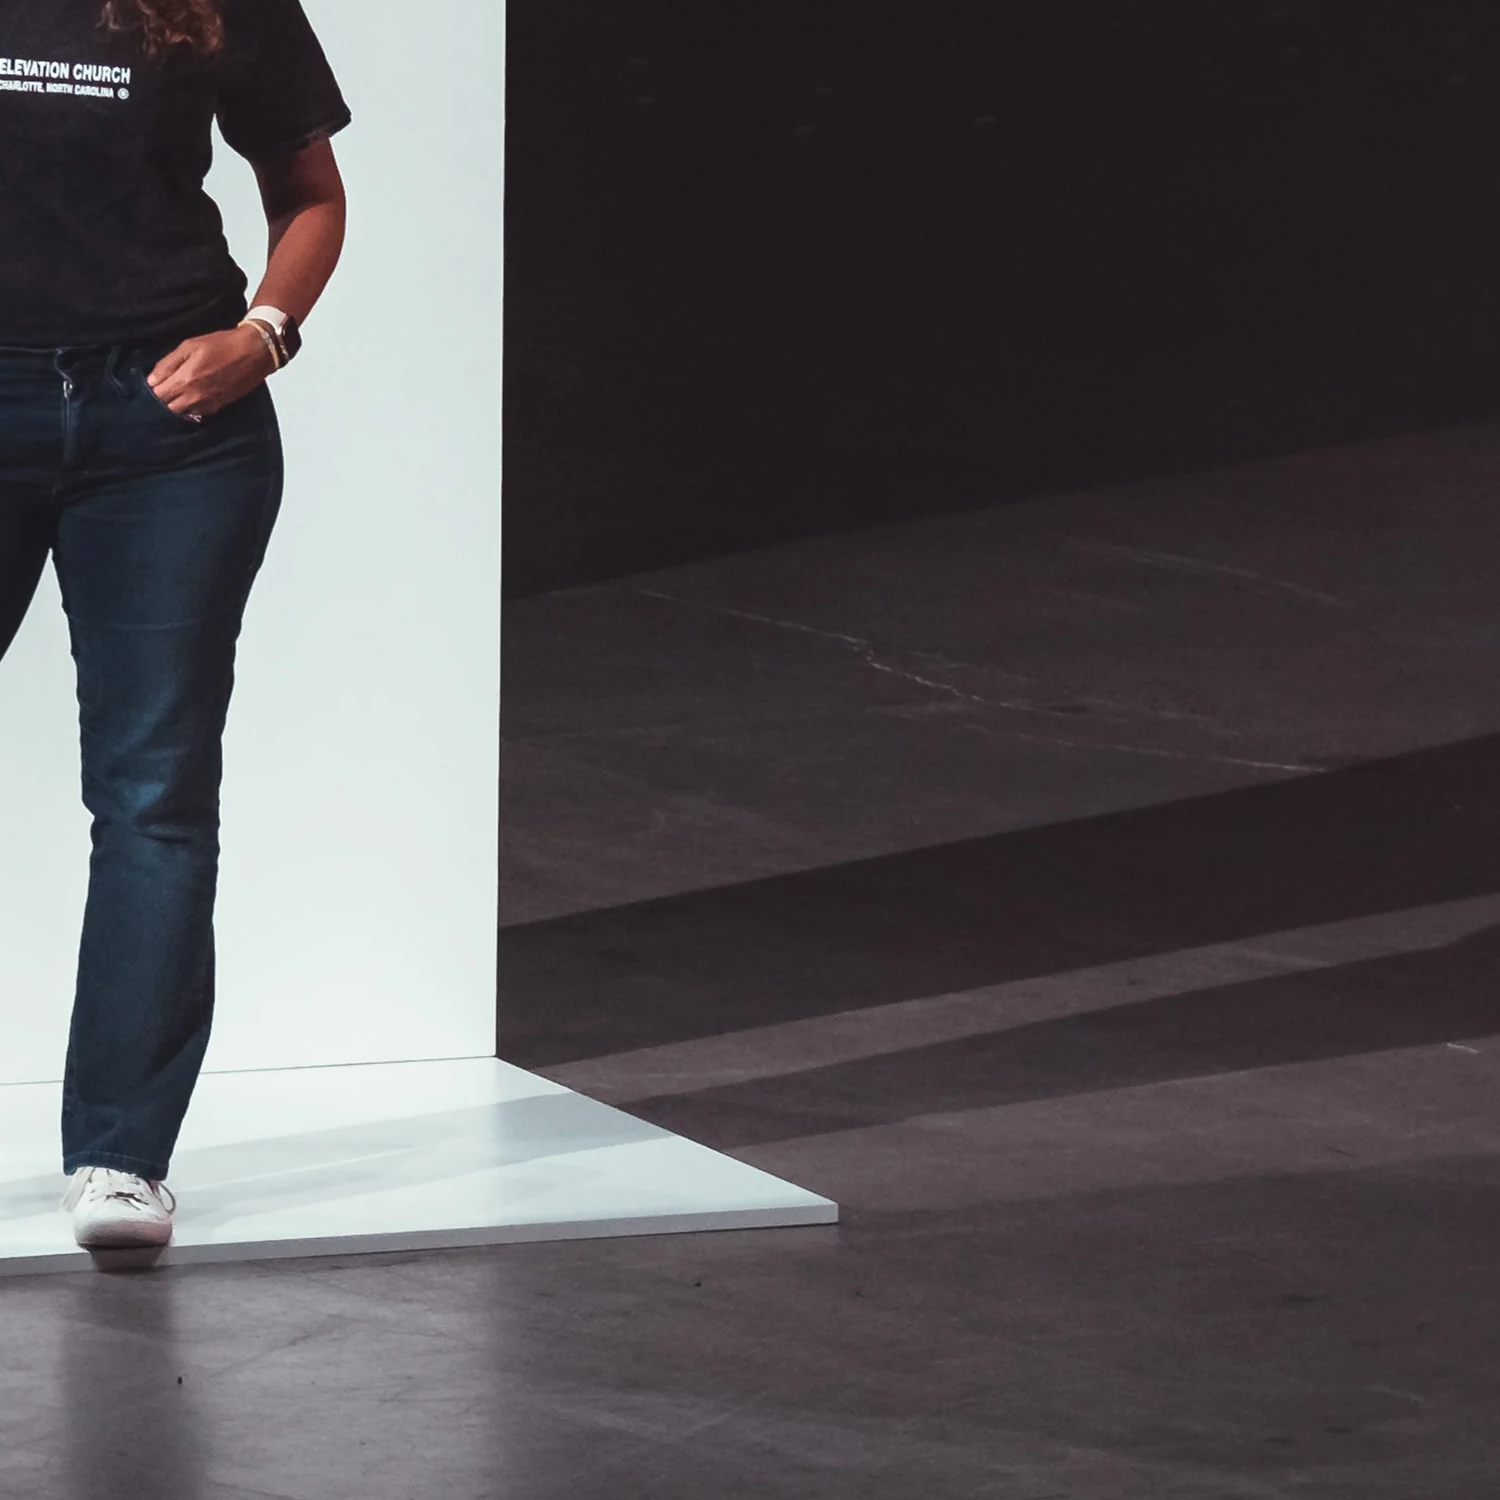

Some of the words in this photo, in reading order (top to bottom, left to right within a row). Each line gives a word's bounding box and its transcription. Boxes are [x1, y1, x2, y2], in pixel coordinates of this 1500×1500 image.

[73, 63, 131, 84] CHURCH
[46, 82, 73, 94] NORTH
[74, 84, 114, 98] CAROLINA
